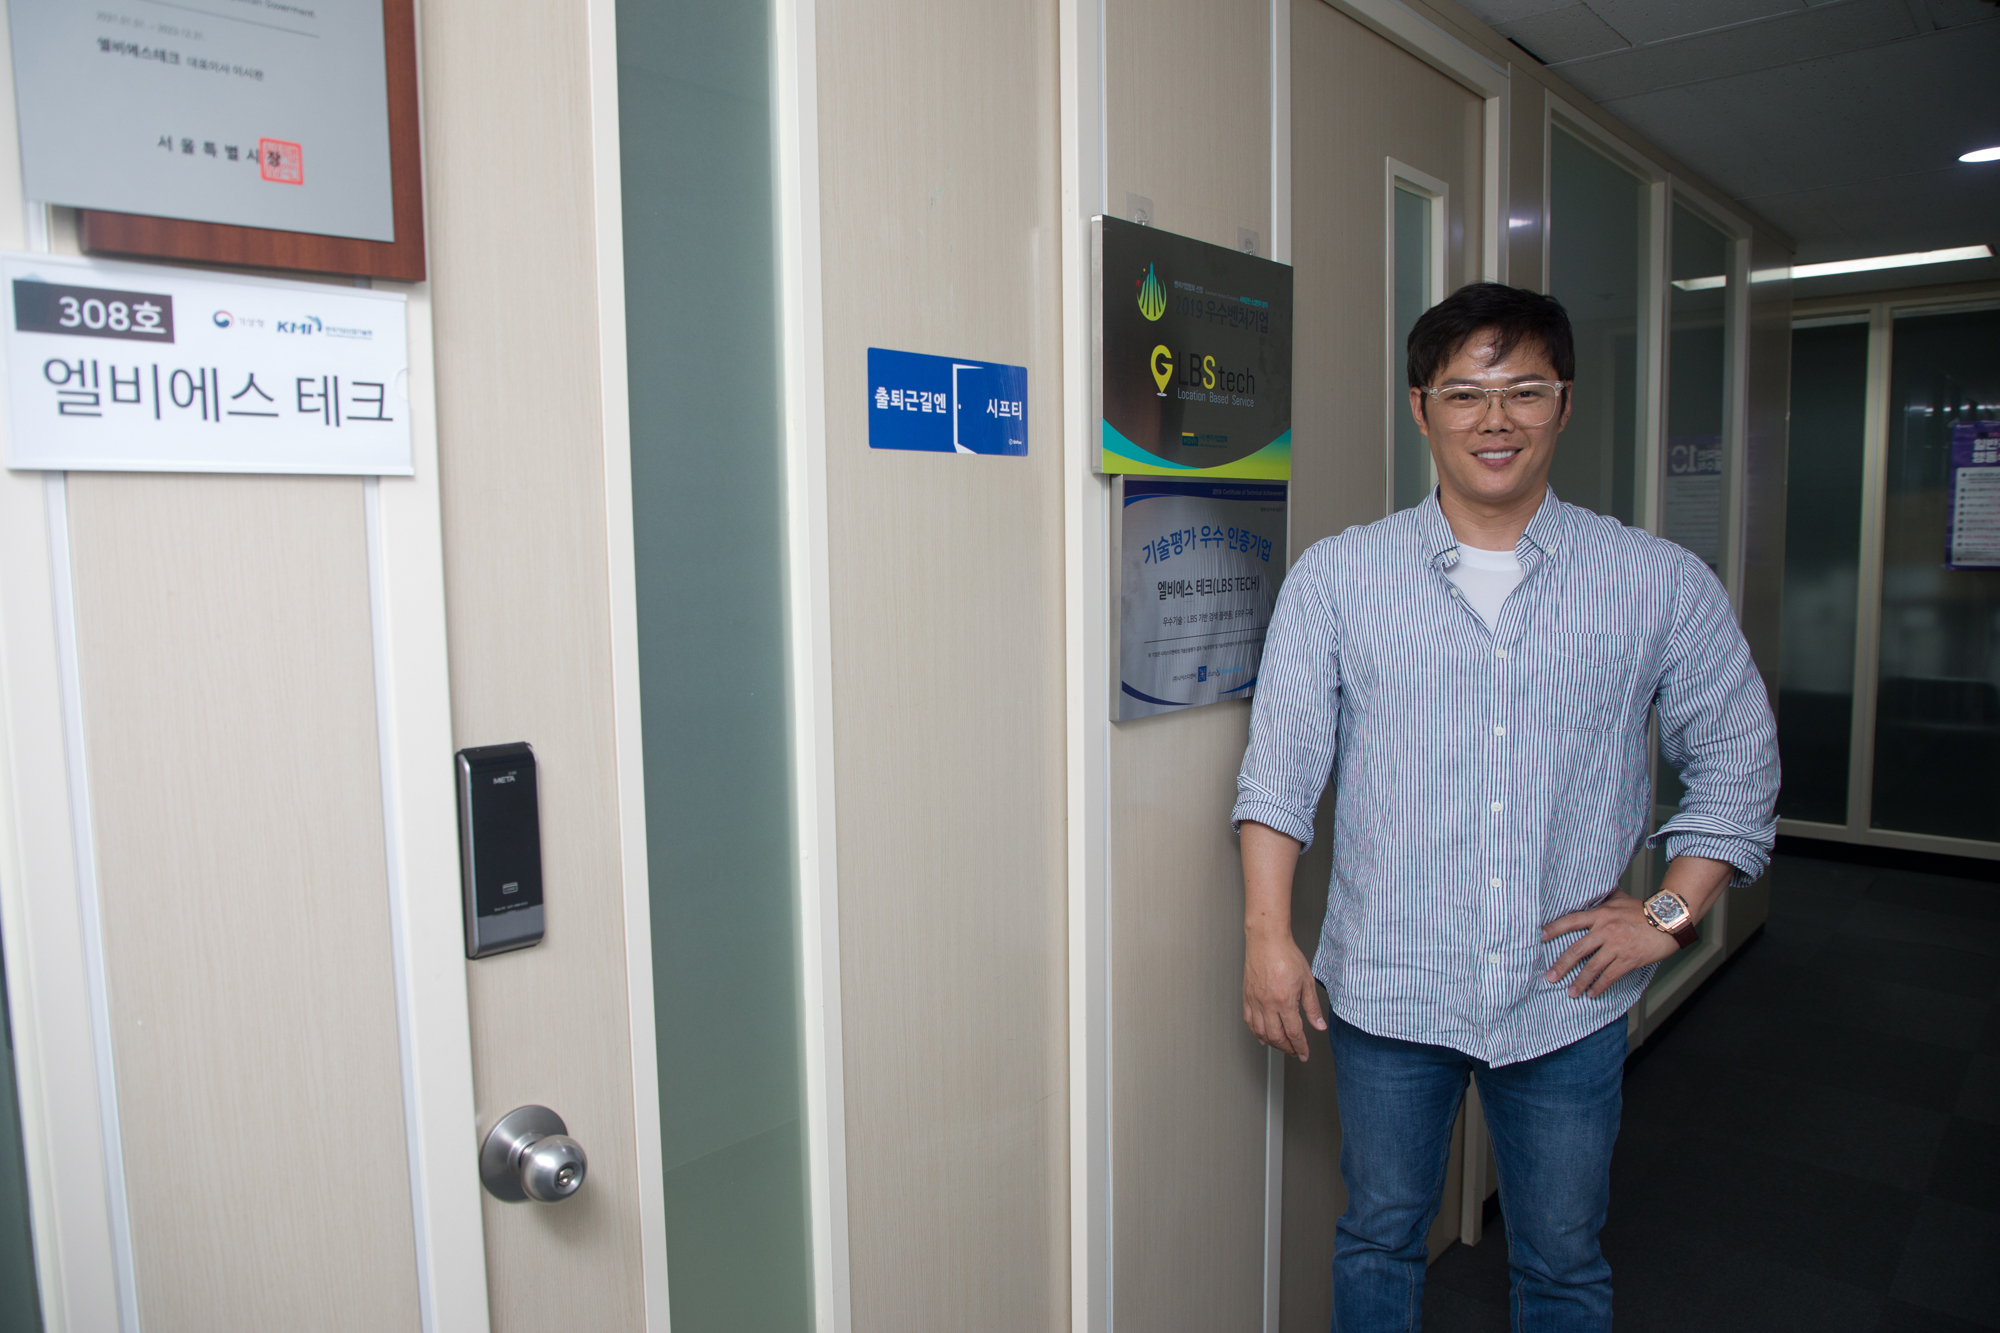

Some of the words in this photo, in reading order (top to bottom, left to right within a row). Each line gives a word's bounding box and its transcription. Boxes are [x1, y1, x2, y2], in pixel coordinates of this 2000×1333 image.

[97, 36, 181, 65] 엘비에스테크
[58, 296, 166, 334] 308호
[276, 320, 312, 335] KMI
[1174, 294, 1203, 319] 2019
[1205, 300, 1269, 334] 우수벤처기업
[43, 357, 279, 422] 엘비에스
[296, 374, 393, 428] 테크
[874, 387, 947, 414] 출퇴근길엔
[1177, 387, 1206, 402] Location
[1209, 391, 1229, 405] Based
[1231, 394, 1255, 408] Service
[986, 398, 1022, 421] 시프티
[1973, 438, 2000, 452] 일반
[1142, 526, 1197, 565] 기술평가
[1199, 525, 1225, 549] 우수
[1227, 527, 1273, 563] 인증기업
[1157, 579, 1194, 601] 엘비에스
[1234, 574, 1260, 594] TECH)
[1162, 616, 1183, 627] 우수기술
[1187, 614, 1198, 624] LBS
[493, 775, 516, 785] META
